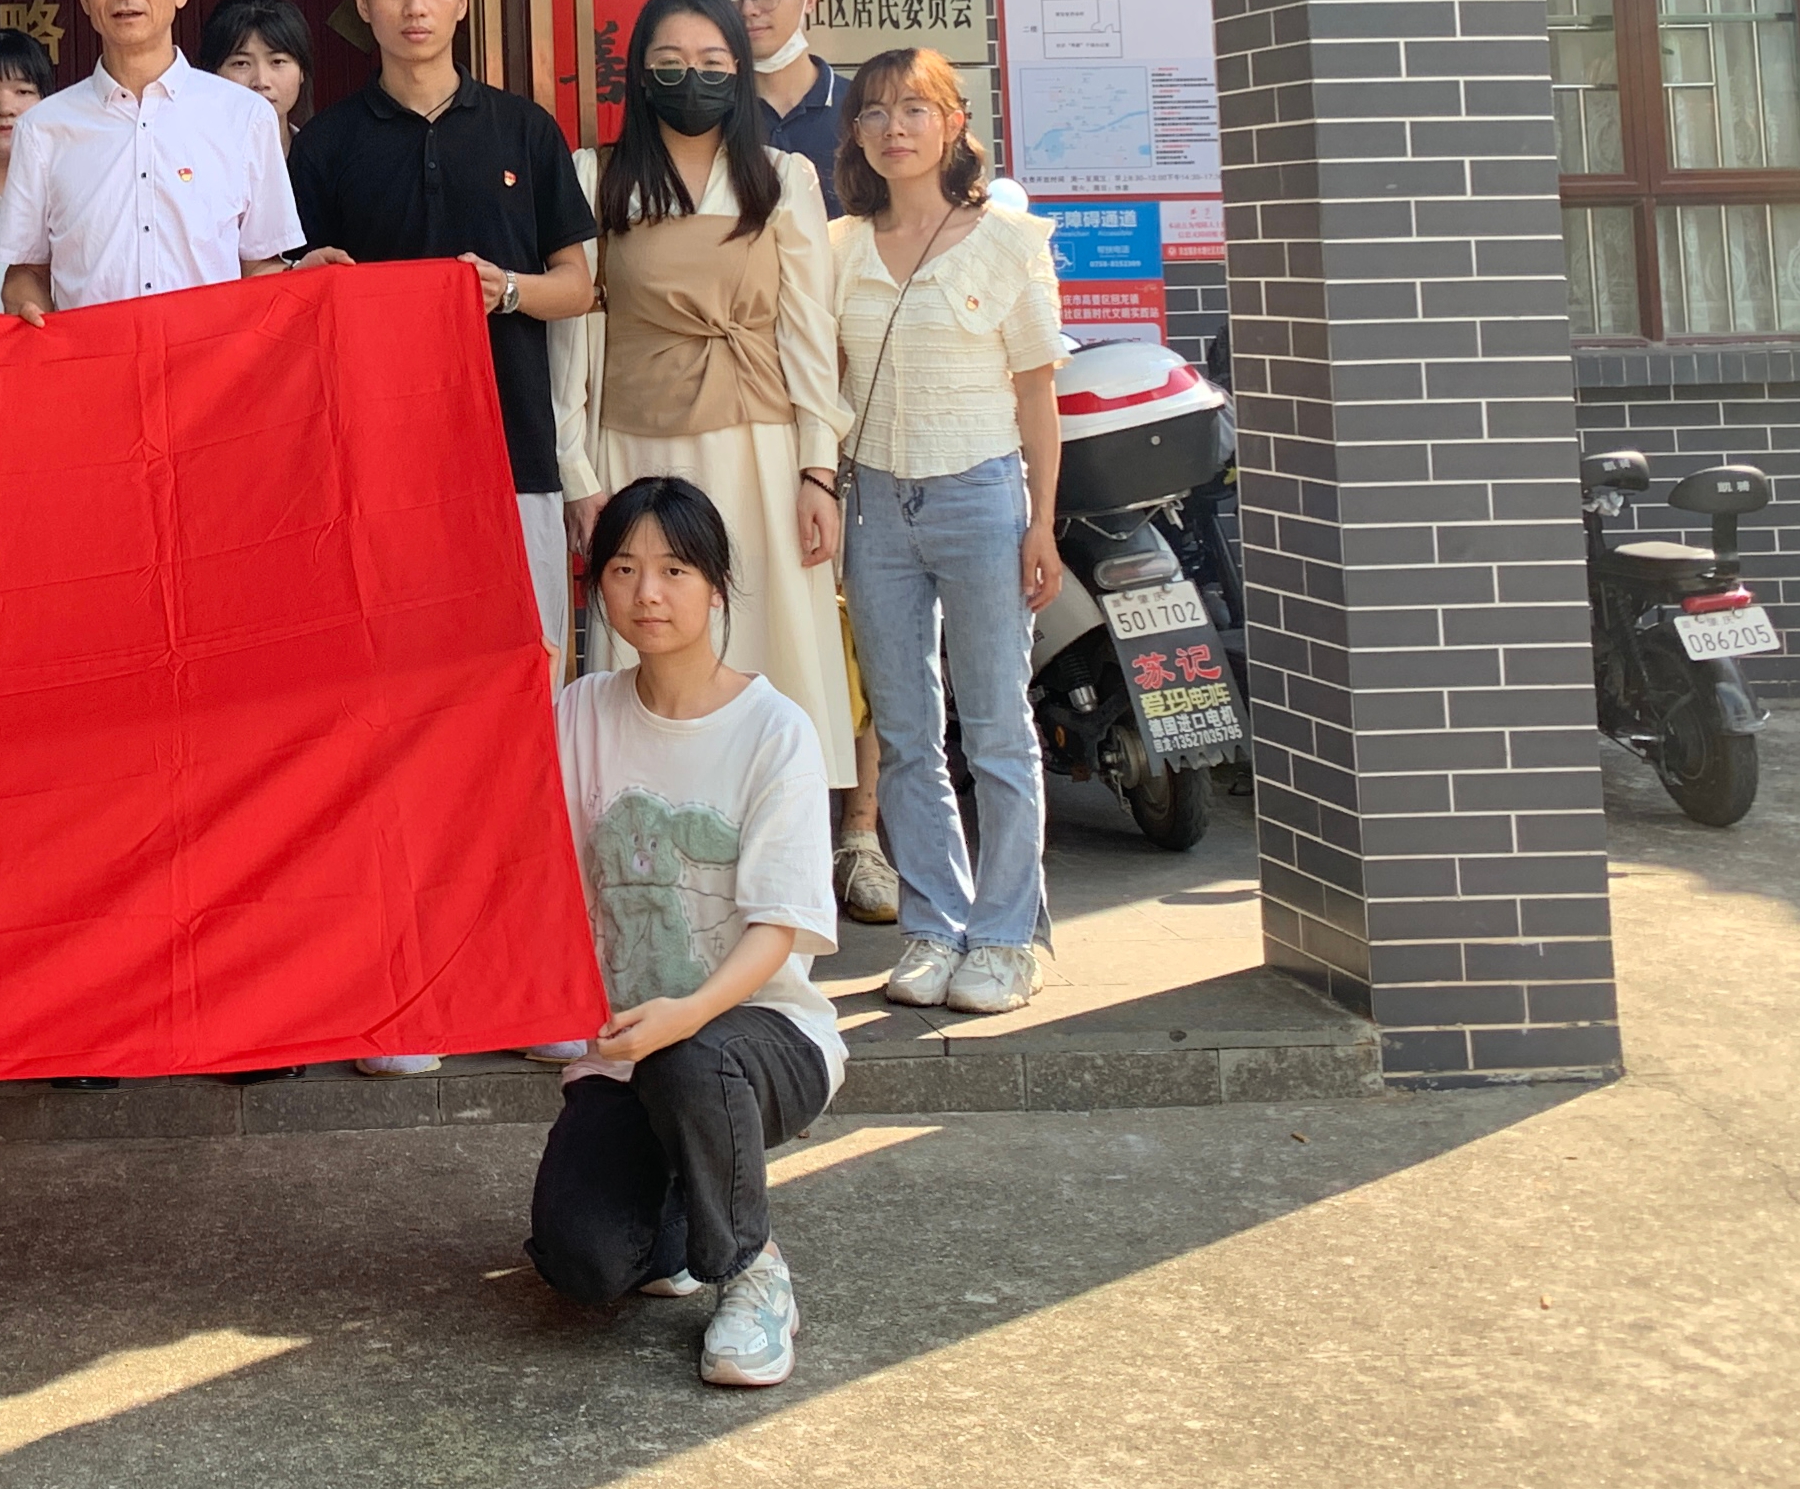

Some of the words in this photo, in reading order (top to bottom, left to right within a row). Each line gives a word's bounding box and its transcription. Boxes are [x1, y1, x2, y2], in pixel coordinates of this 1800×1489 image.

[1060, 294, 1140, 305] 庆市高要区回龙镇
[1061, 306, 1160, 319] 社区新时代文明实践站
[1117, 601, 1201, 633] 501702
[1688, 624, 1772, 654] 086205
[1132, 644, 1222, 689] 苏记
[1139, 682, 1232, 719] 爱玛电动车
[1148, 706, 1238, 738] 德国进口电机
